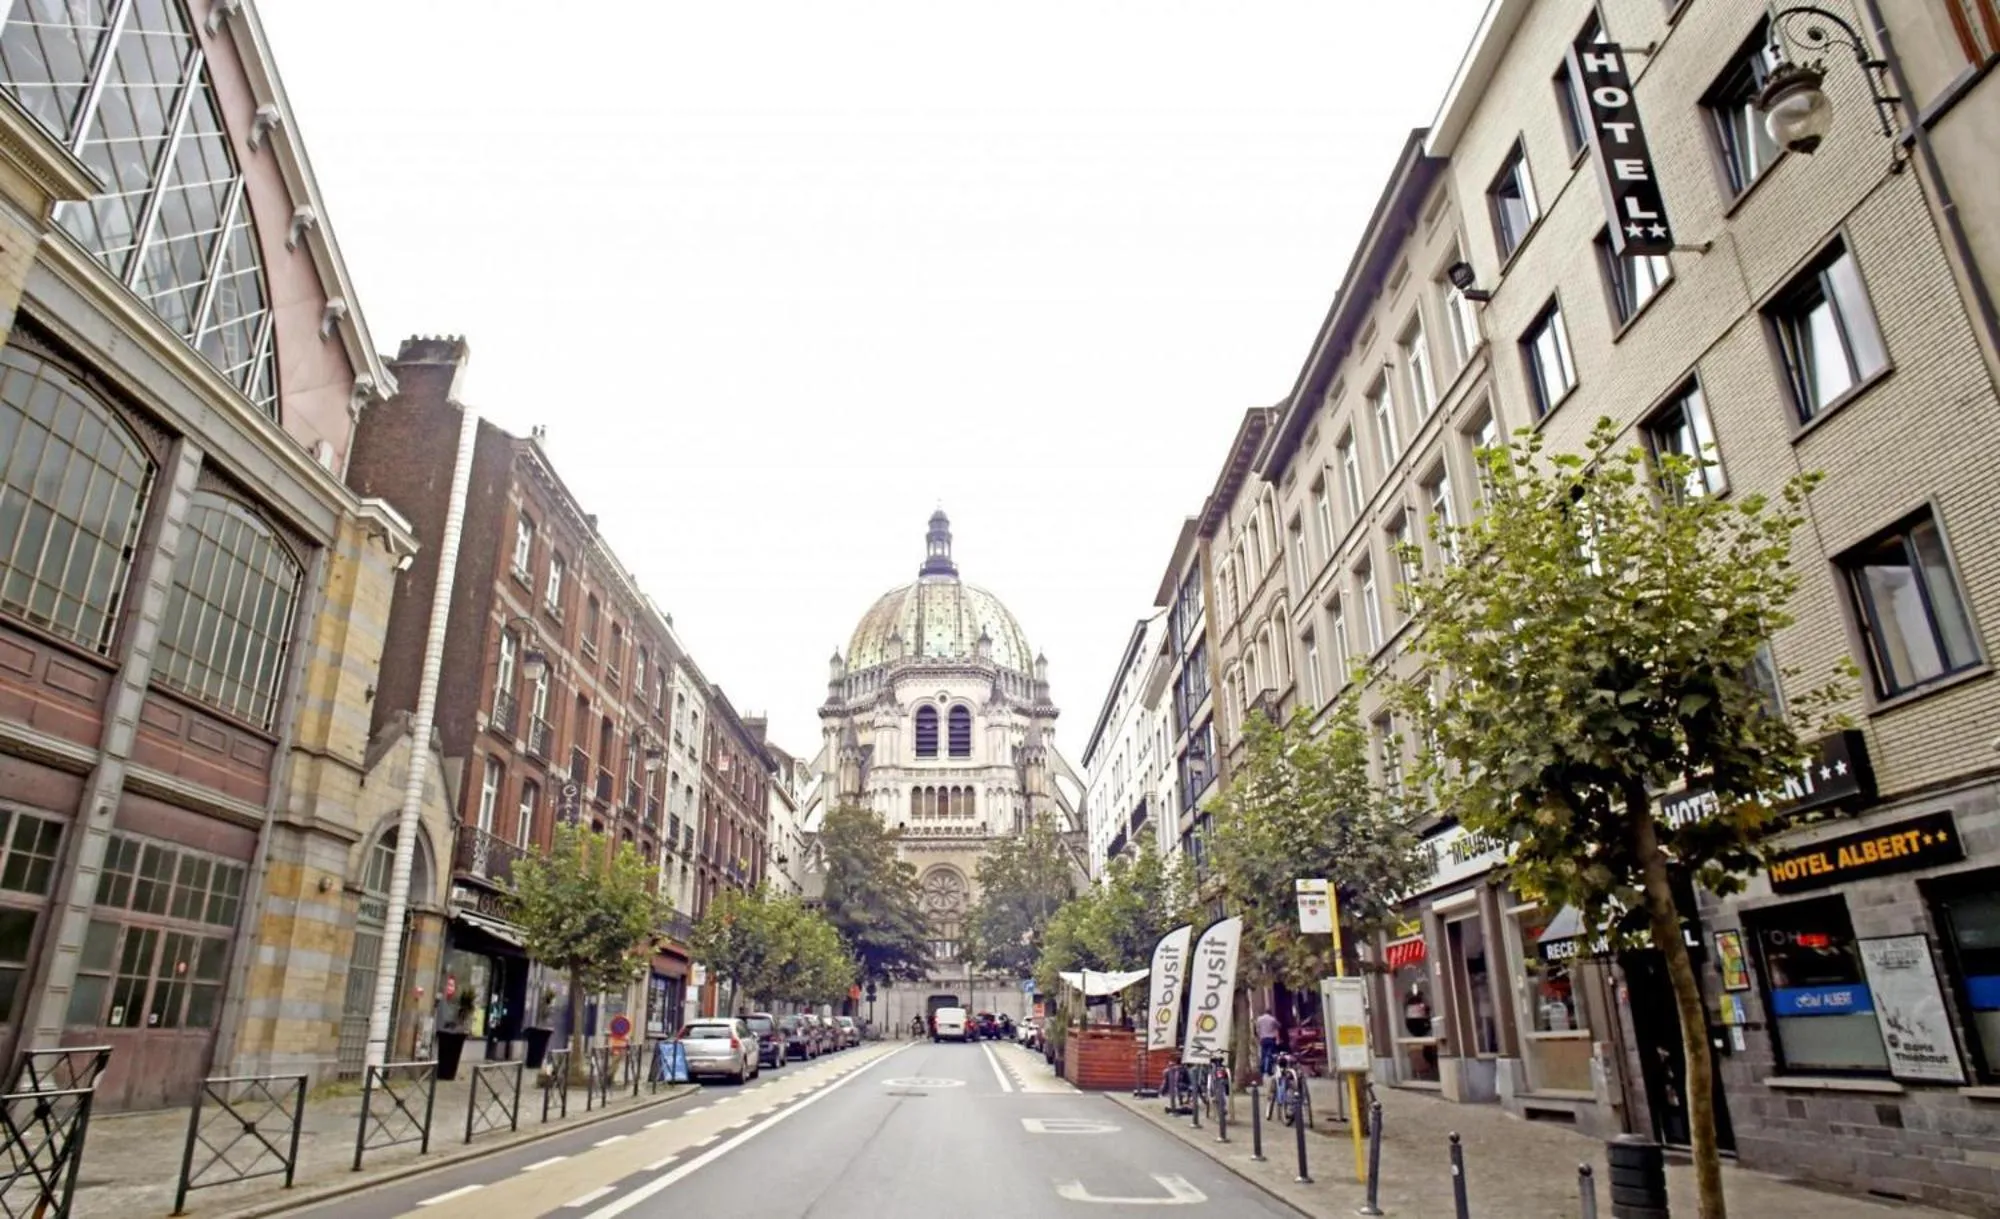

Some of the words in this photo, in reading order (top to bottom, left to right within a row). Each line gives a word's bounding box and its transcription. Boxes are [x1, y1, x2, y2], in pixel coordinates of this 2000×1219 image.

[1583, 52, 1658, 219] HOTEL
[1771, 852, 1836, 883] HOTEL
[1838, 830, 1921, 868] ALBERT
